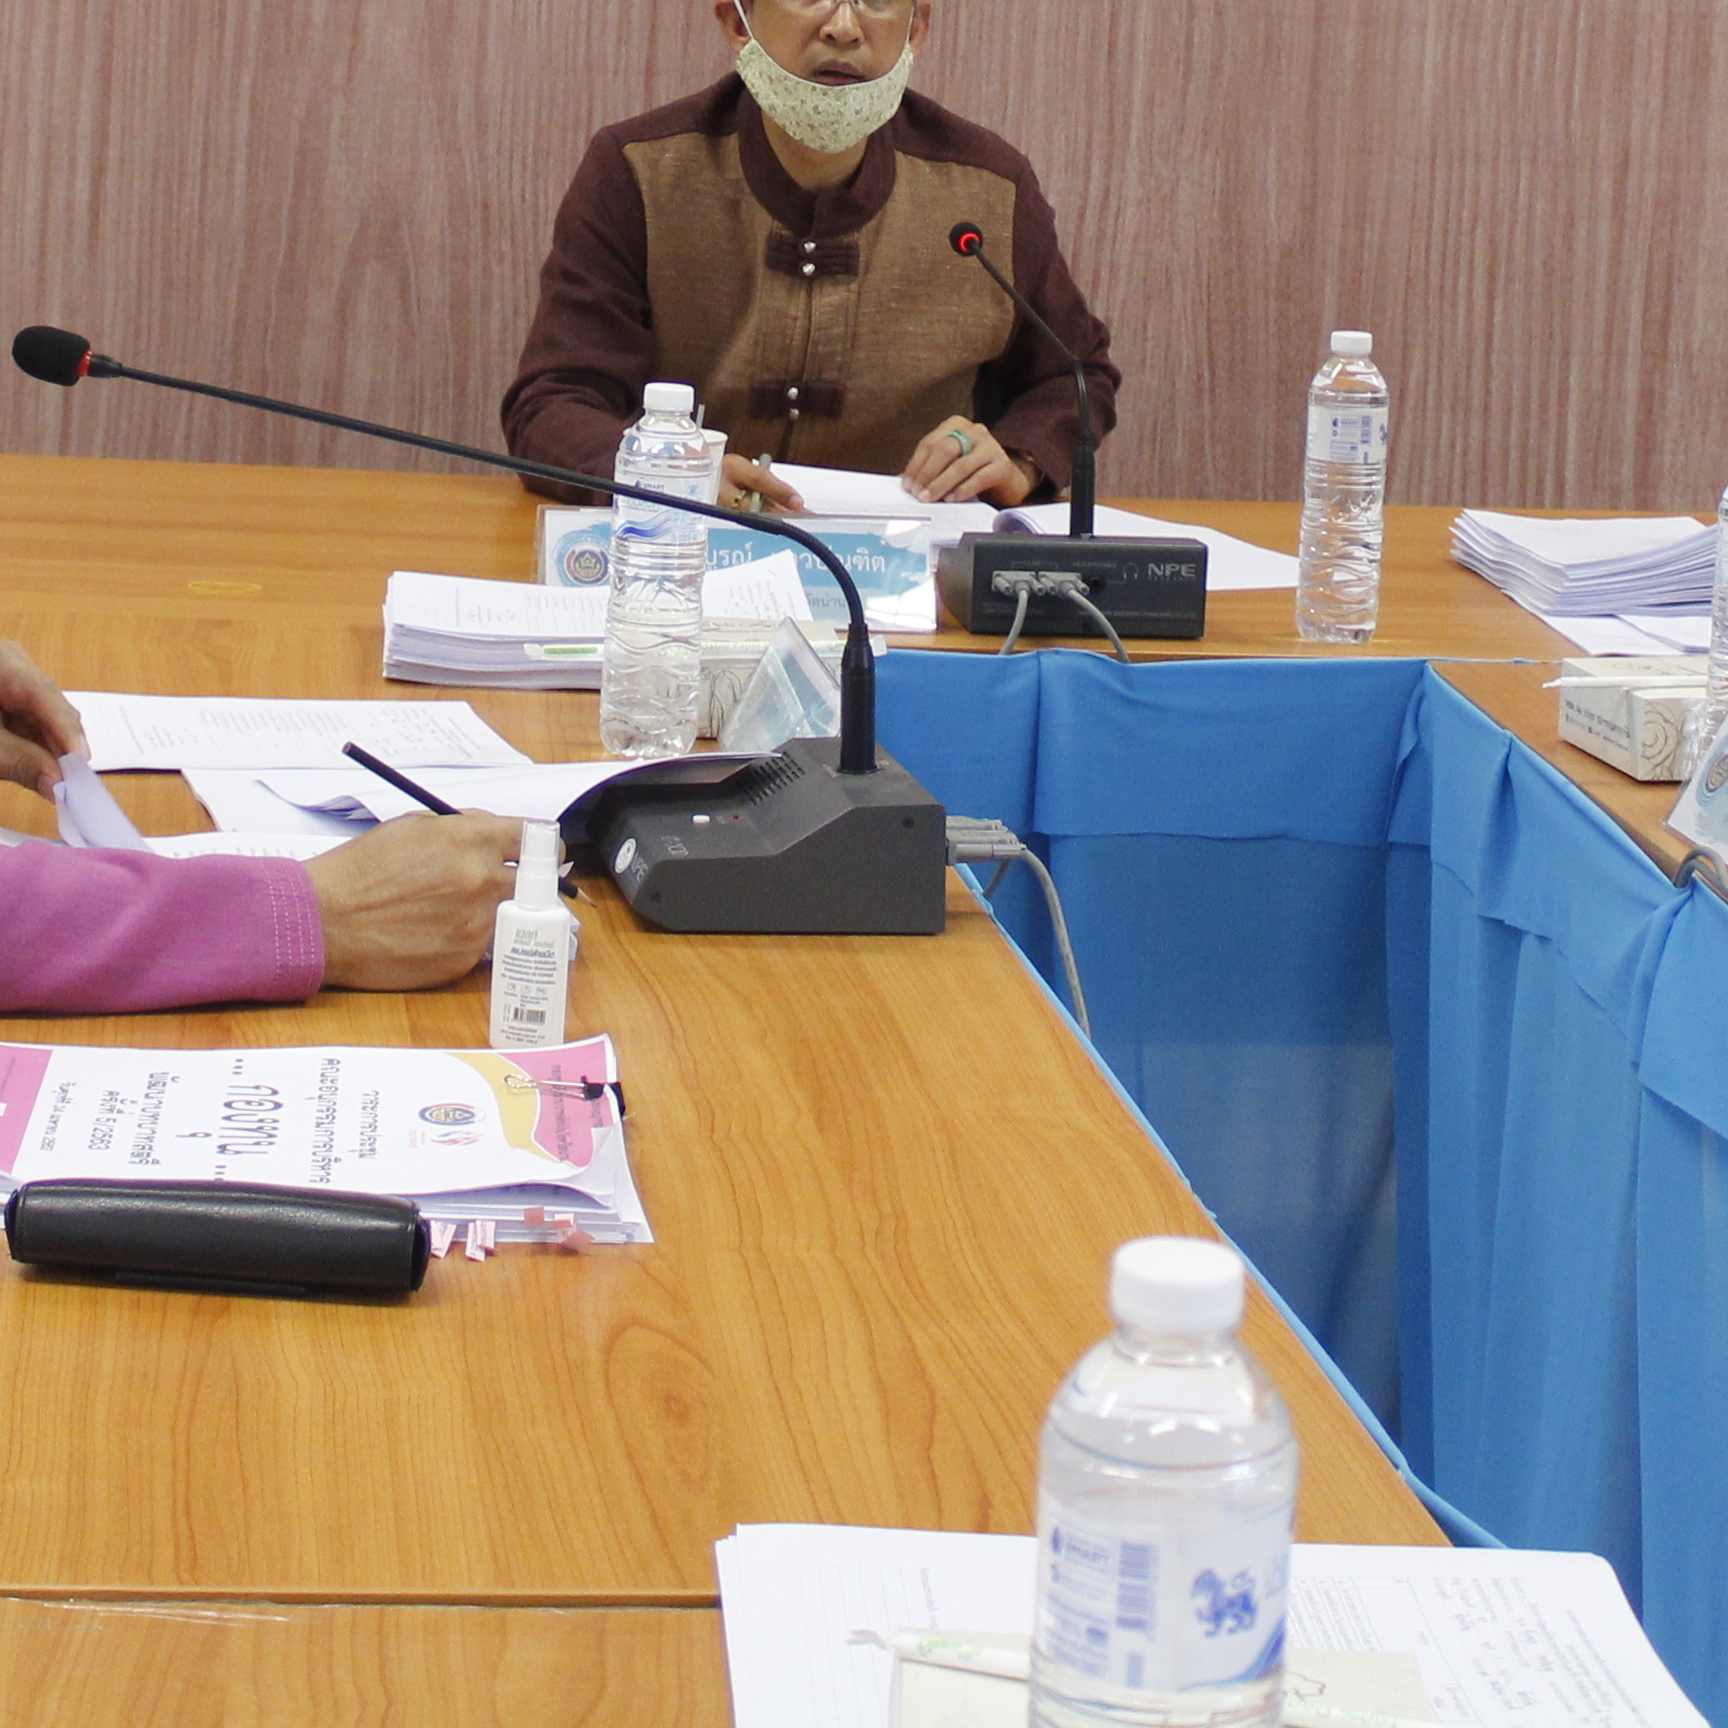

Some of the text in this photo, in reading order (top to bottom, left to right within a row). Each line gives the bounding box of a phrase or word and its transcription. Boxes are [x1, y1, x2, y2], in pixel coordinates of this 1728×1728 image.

[1148, 563, 1196, 577] NPE
[87, 1090, 138, 1151] ครั้งที่ 5/2563
[128, 1072, 180, 1166] พัฒนาบทบาทสตรี
[175, 1085, 283, 1155] กองทุน
[304, 1058, 342, 1184] คณะอนุกรรมการบริหาร
